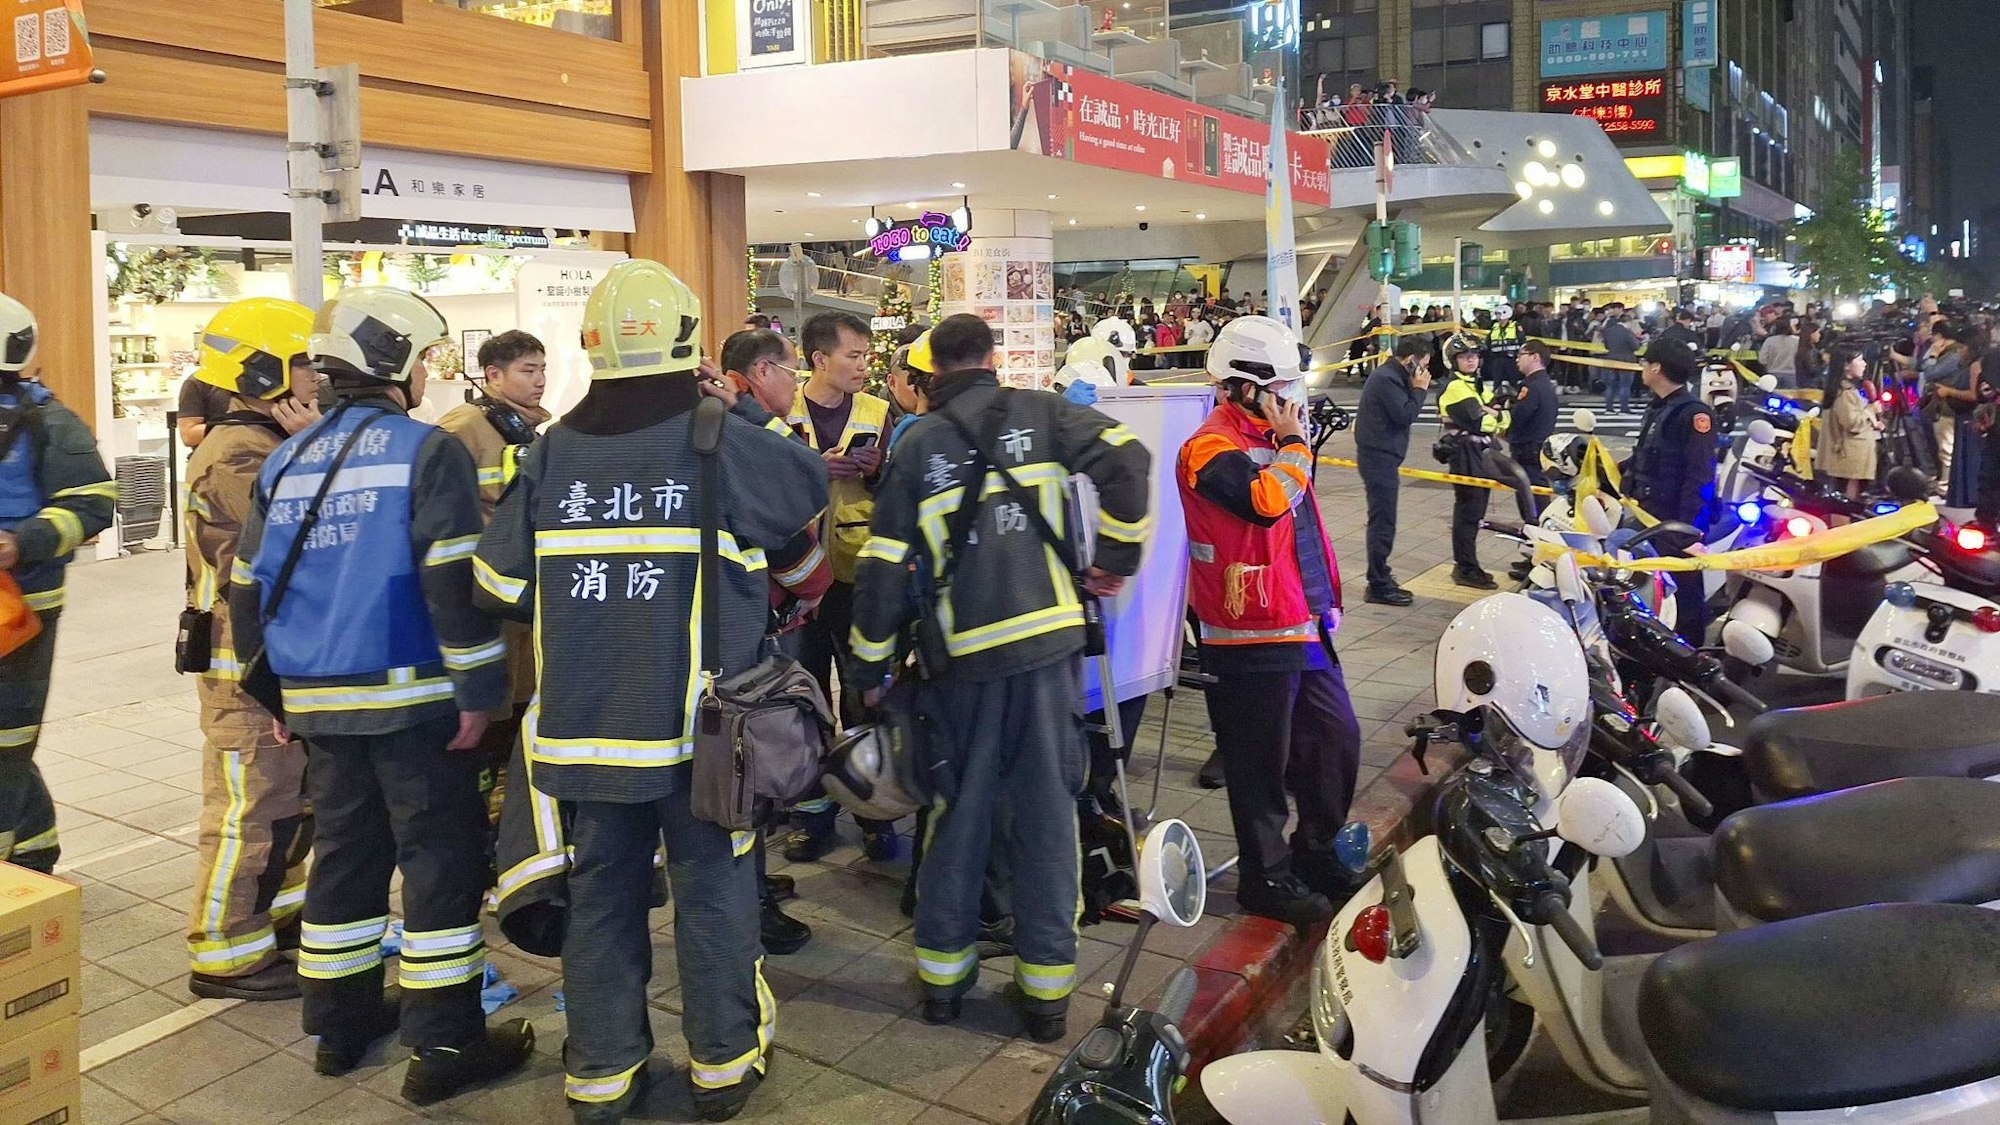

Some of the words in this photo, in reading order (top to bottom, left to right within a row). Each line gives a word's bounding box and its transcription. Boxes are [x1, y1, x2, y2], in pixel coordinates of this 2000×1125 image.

[753, 0, 791, 14] Only
[1546, 78, 1662, 102] 京水堂中醫診所
[1080, 95, 1181, 143] 在誠品，時光正好
[1080, 131, 1098, 146] Having
[1103, 138, 1116, 148] good
[1232, 136, 1303, 187] 誠品聯卡
[411, 179, 485, 199] 和樂家居
[415, 224, 460, 242] 誠品生活
[460, 227, 478, 242] the
[504, 232, 549, 246] spectrum
[911, 225, 929, 243] to
[560, 269, 593, 280] HOLA
[620, 319, 657, 336] 三大
[873, 315, 904, 329] HOLA
[558, 478, 690, 523] 臺北市
[570, 559, 665, 602] 消防
